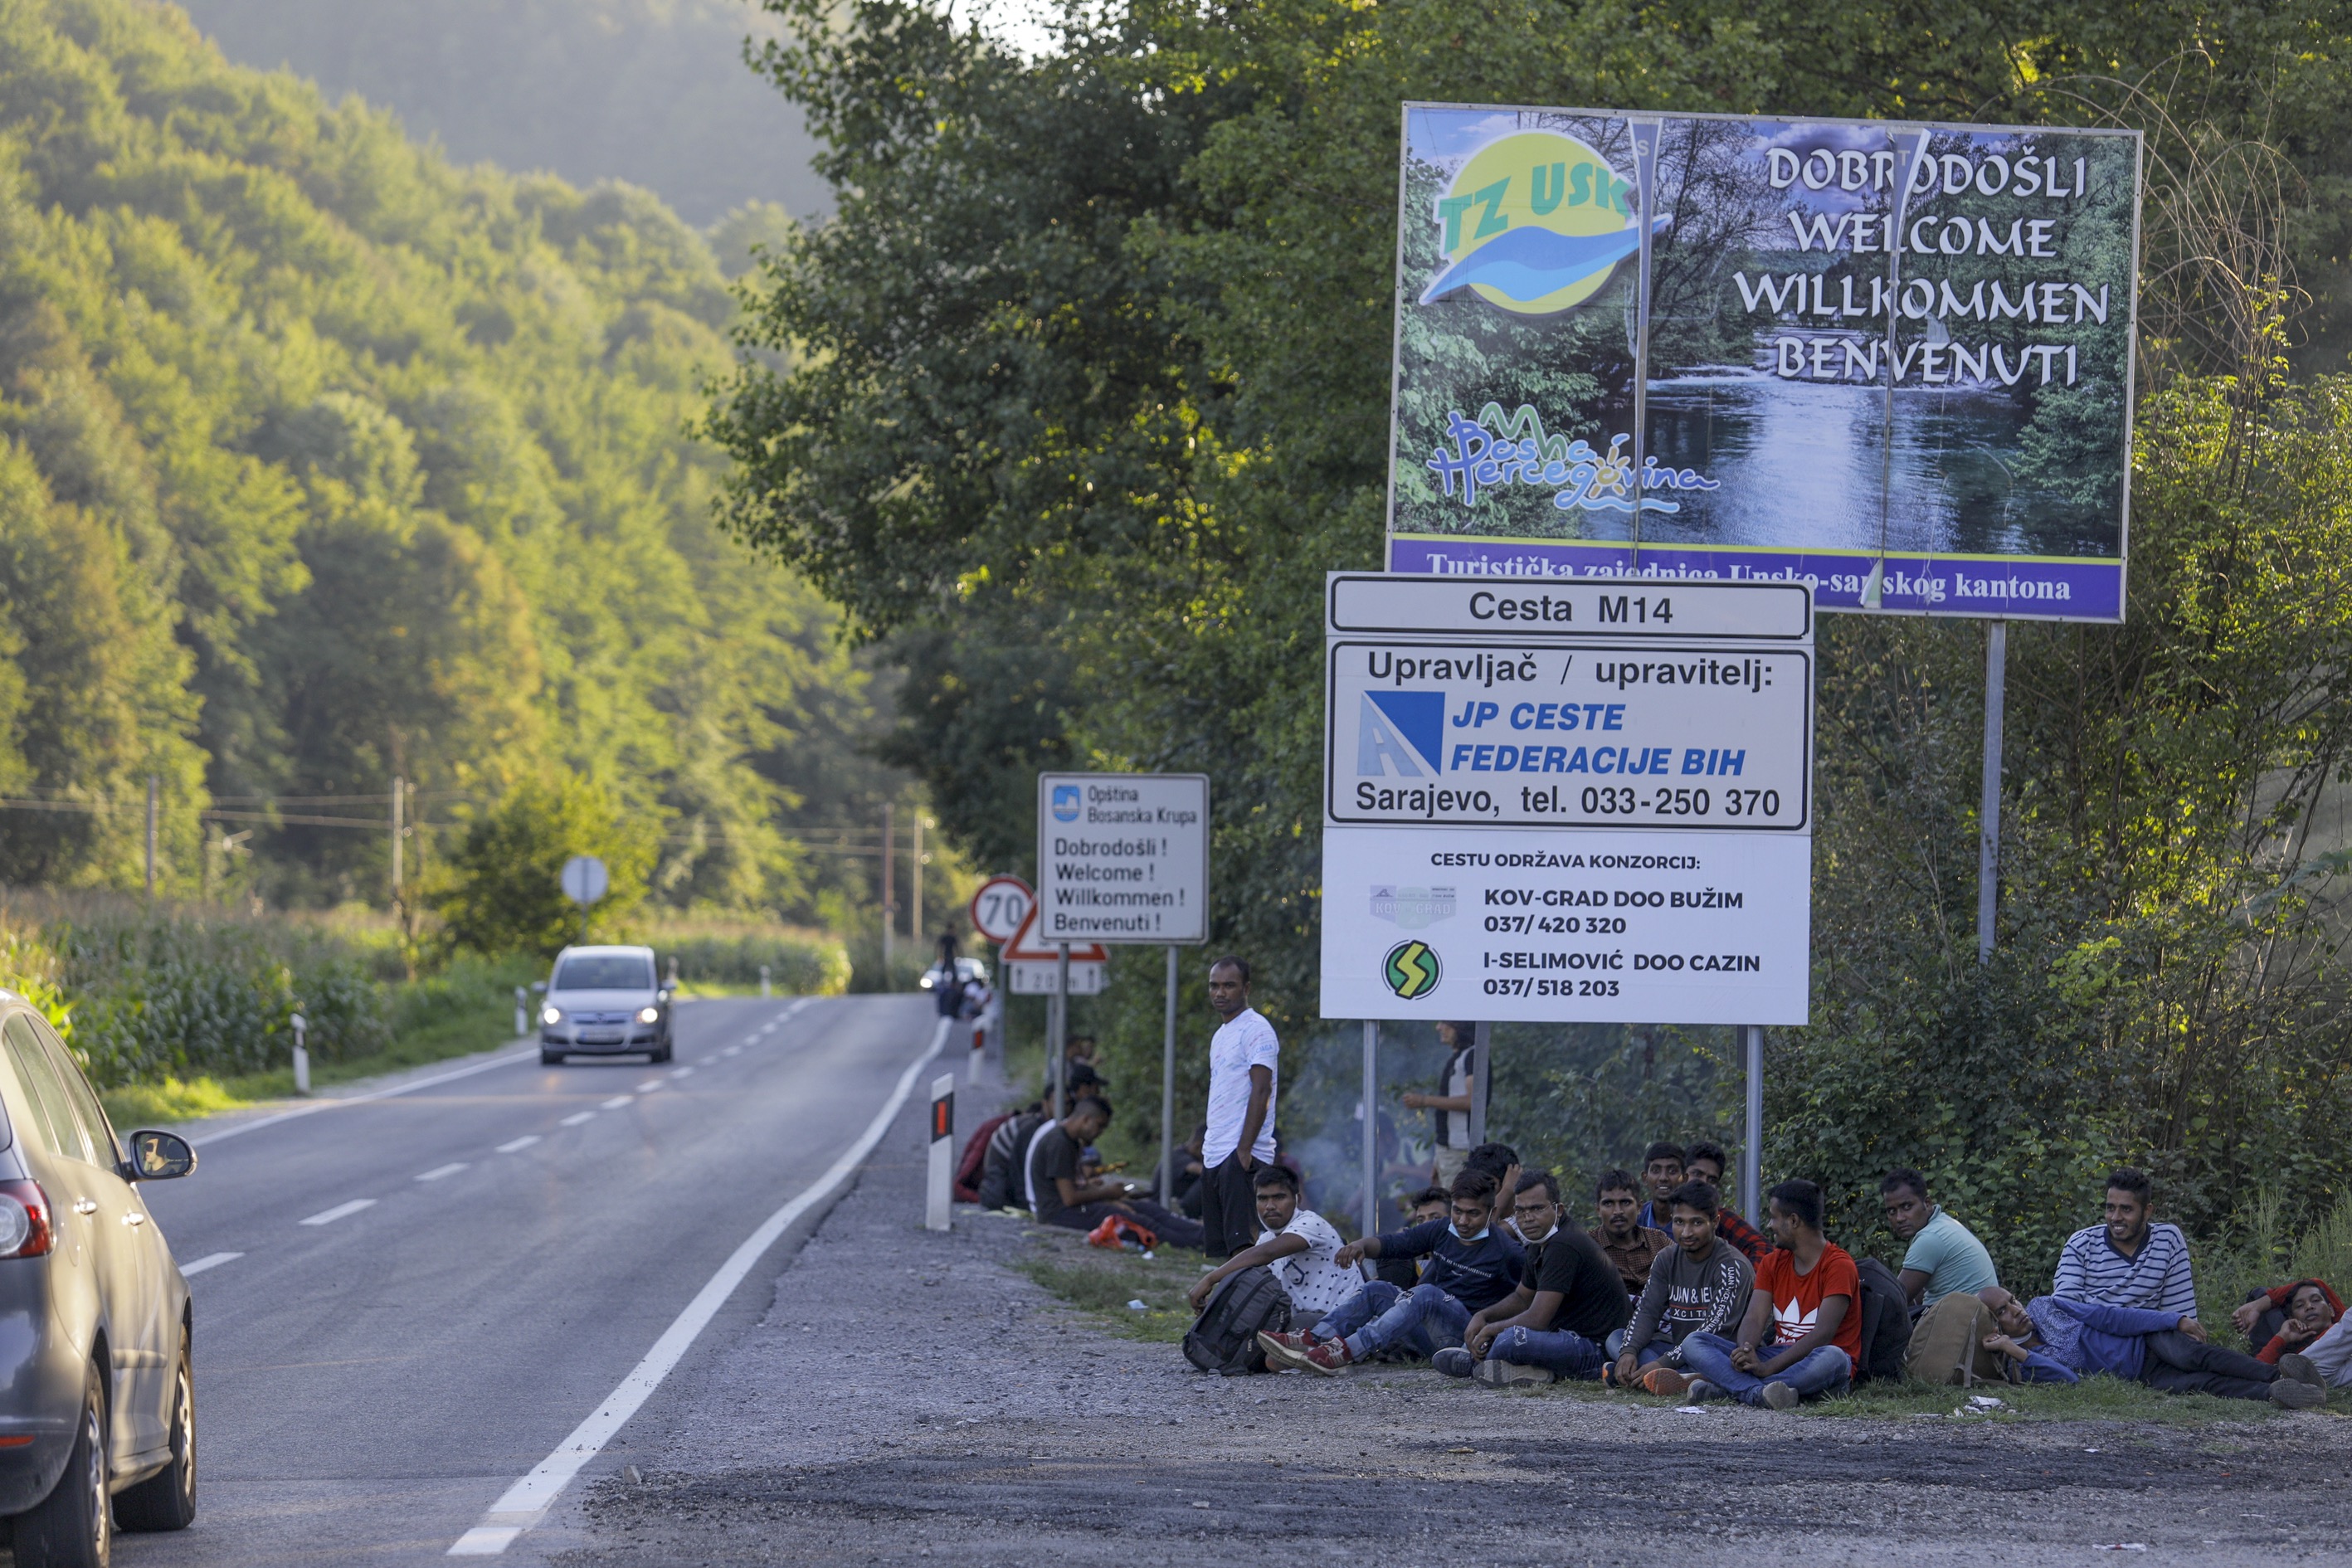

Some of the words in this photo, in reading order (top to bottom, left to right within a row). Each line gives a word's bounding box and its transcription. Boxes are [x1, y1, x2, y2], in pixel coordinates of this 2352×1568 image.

[1438, 176, 1511, 253] TZ
[1531, 163, 1633, 219] USK
[1732, 270, 2109, 325] WILLKOMMEN
[1773, 336, 2077, 387] BENVENUTI
[1955, 573, 2072, 601] kantona
[1469, 592, 1573, 622] Cesta
[1599, 596, 1673, 624] M14
[1369, 651, 1537, 687] Upravljač
[1595, 659, 1773, 693] upravitelj:
[1452, 701, 1499, 729] JP
[1510, 703, 1626, 731] CESTE
[1450, 744, 1674, 775] FEDERACIJE
[1680, 749, 1746, 776] BIH
[1356, 782, 1500, 818] Sarajevo,
[1522, 785, 1567, 812] tel.
[1581, 787, 1711, 816] 033-250
[1725, 789, 1780, 816] 370
[1088, 807, 1152, 824] Bosanska
[1157, 807, 1197, 827] Krupa
[1054, 837, 1157, 856] Dobrodošli
[1055, 863, 1143, 881] Welcome
[1430, 852, 1490, 867] CESTU
[1494, 850, 1585, 869] ODRŽAVA
[1590, 854, 1701, 870] KONZORCIJ:
[1055, 888, 1174, 907] Willkommen
[1483, 889, 1609, 908] KOV-GRAD
[1613, 890, 1665, 908] DOO
[1670, 886, 1744, 909] BUŽIM
[984, 894, 1025, 928] 70
[1054, 913, 1151, 932] Benvenuti
[1585, 917, 1626, 934] 320
[1483, 949, 1624, 971] I-SELIMOVIĆ
[1634, 953, 1684, 971] DOO
[1689, 954, 1760, 972] CAZIN
[1578, 980, 1619, 997] 203
